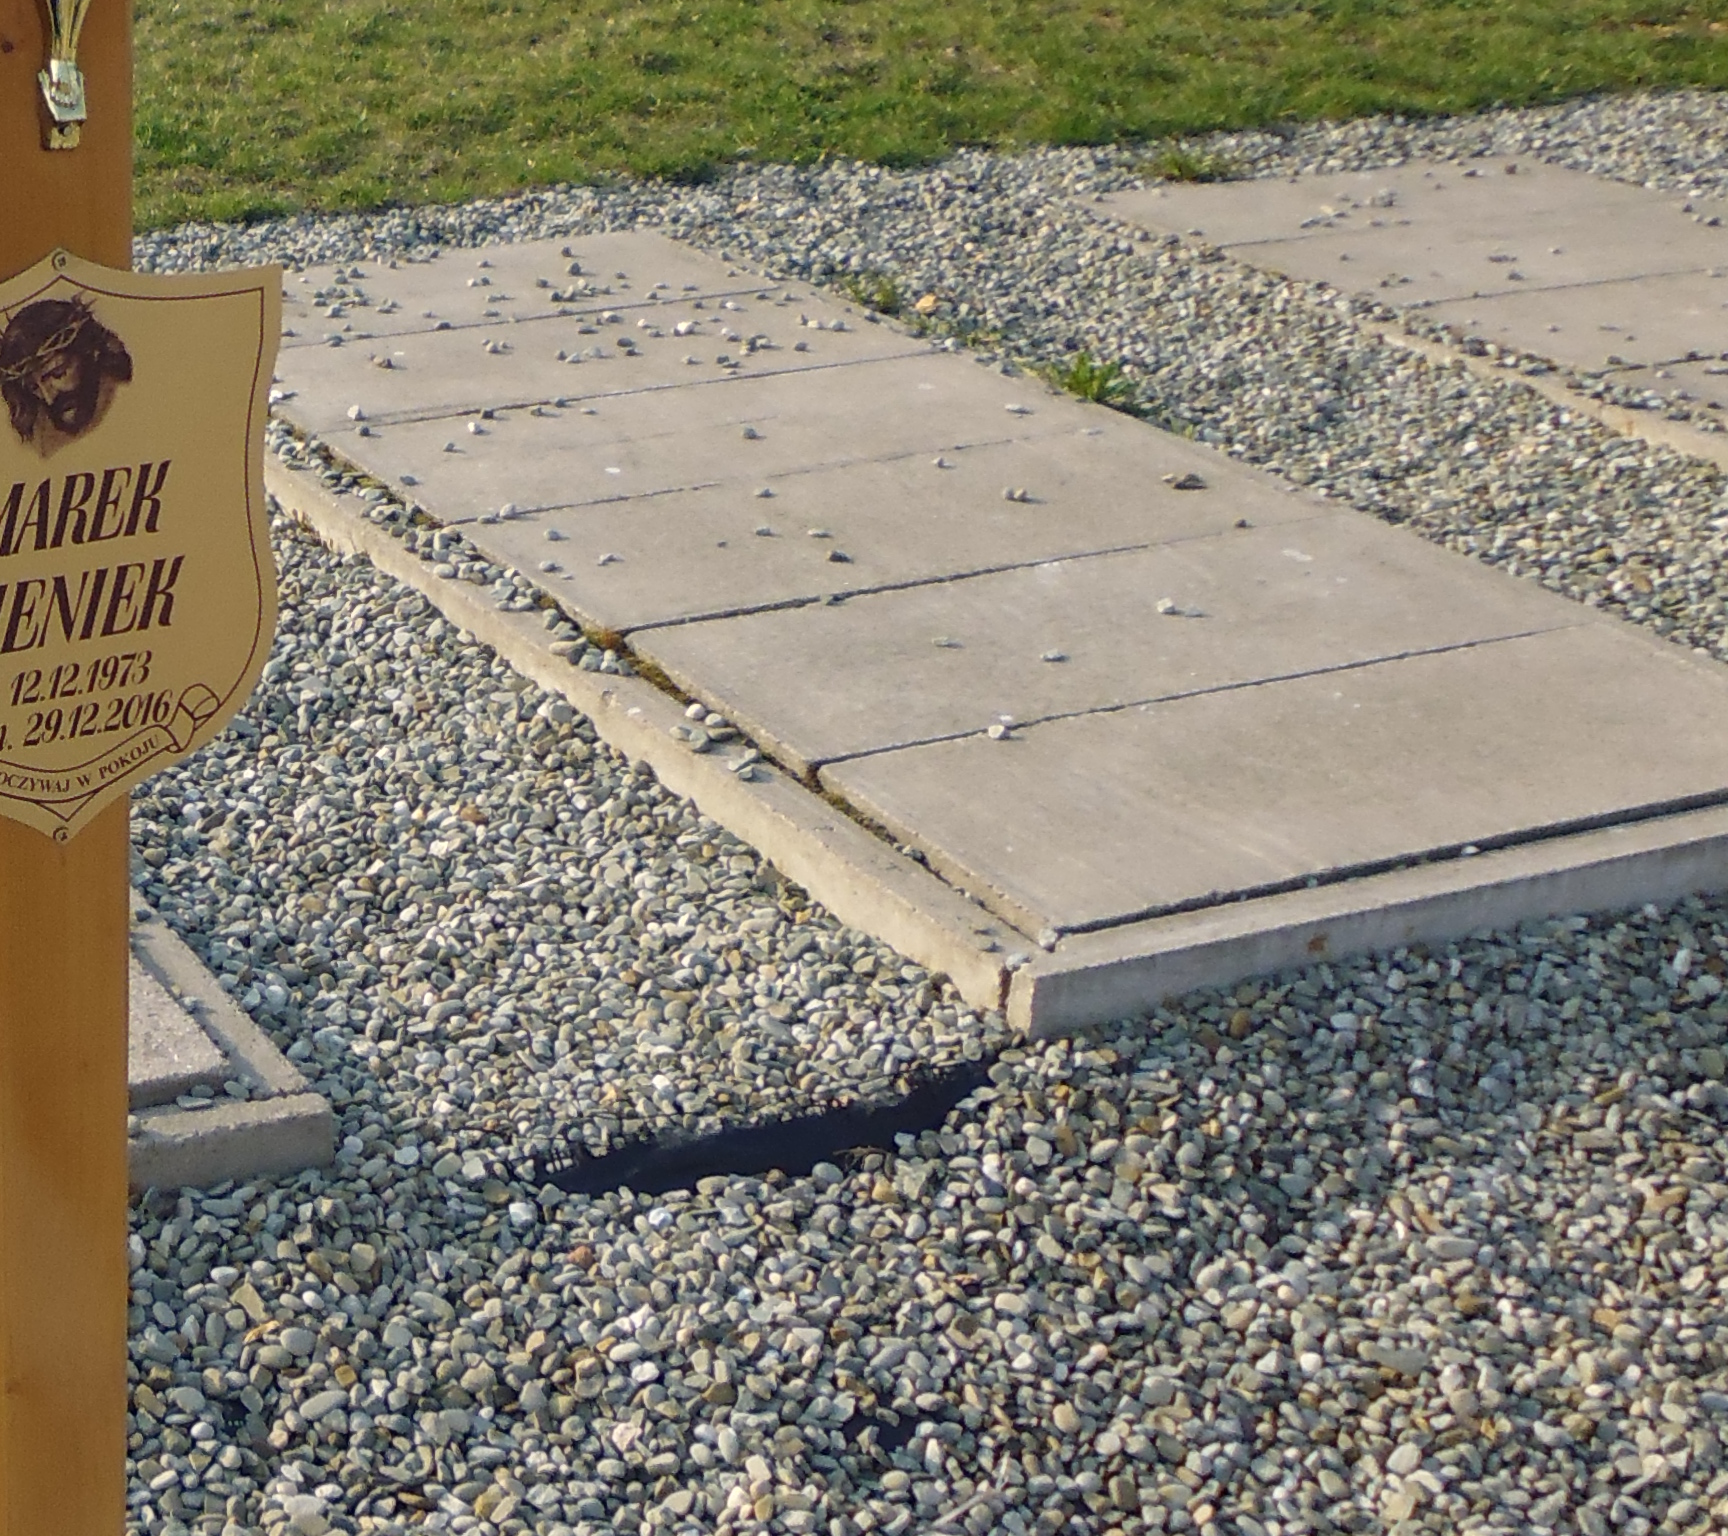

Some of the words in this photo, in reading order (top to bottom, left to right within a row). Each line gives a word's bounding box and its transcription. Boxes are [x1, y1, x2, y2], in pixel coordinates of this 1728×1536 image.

[10, 650, 153, 707] 12.12.1973
[22, 689, 174, 747] 29.12.2016
[77, 776, 92, 788] W
[99, 734, 162, 781] POKOJU
